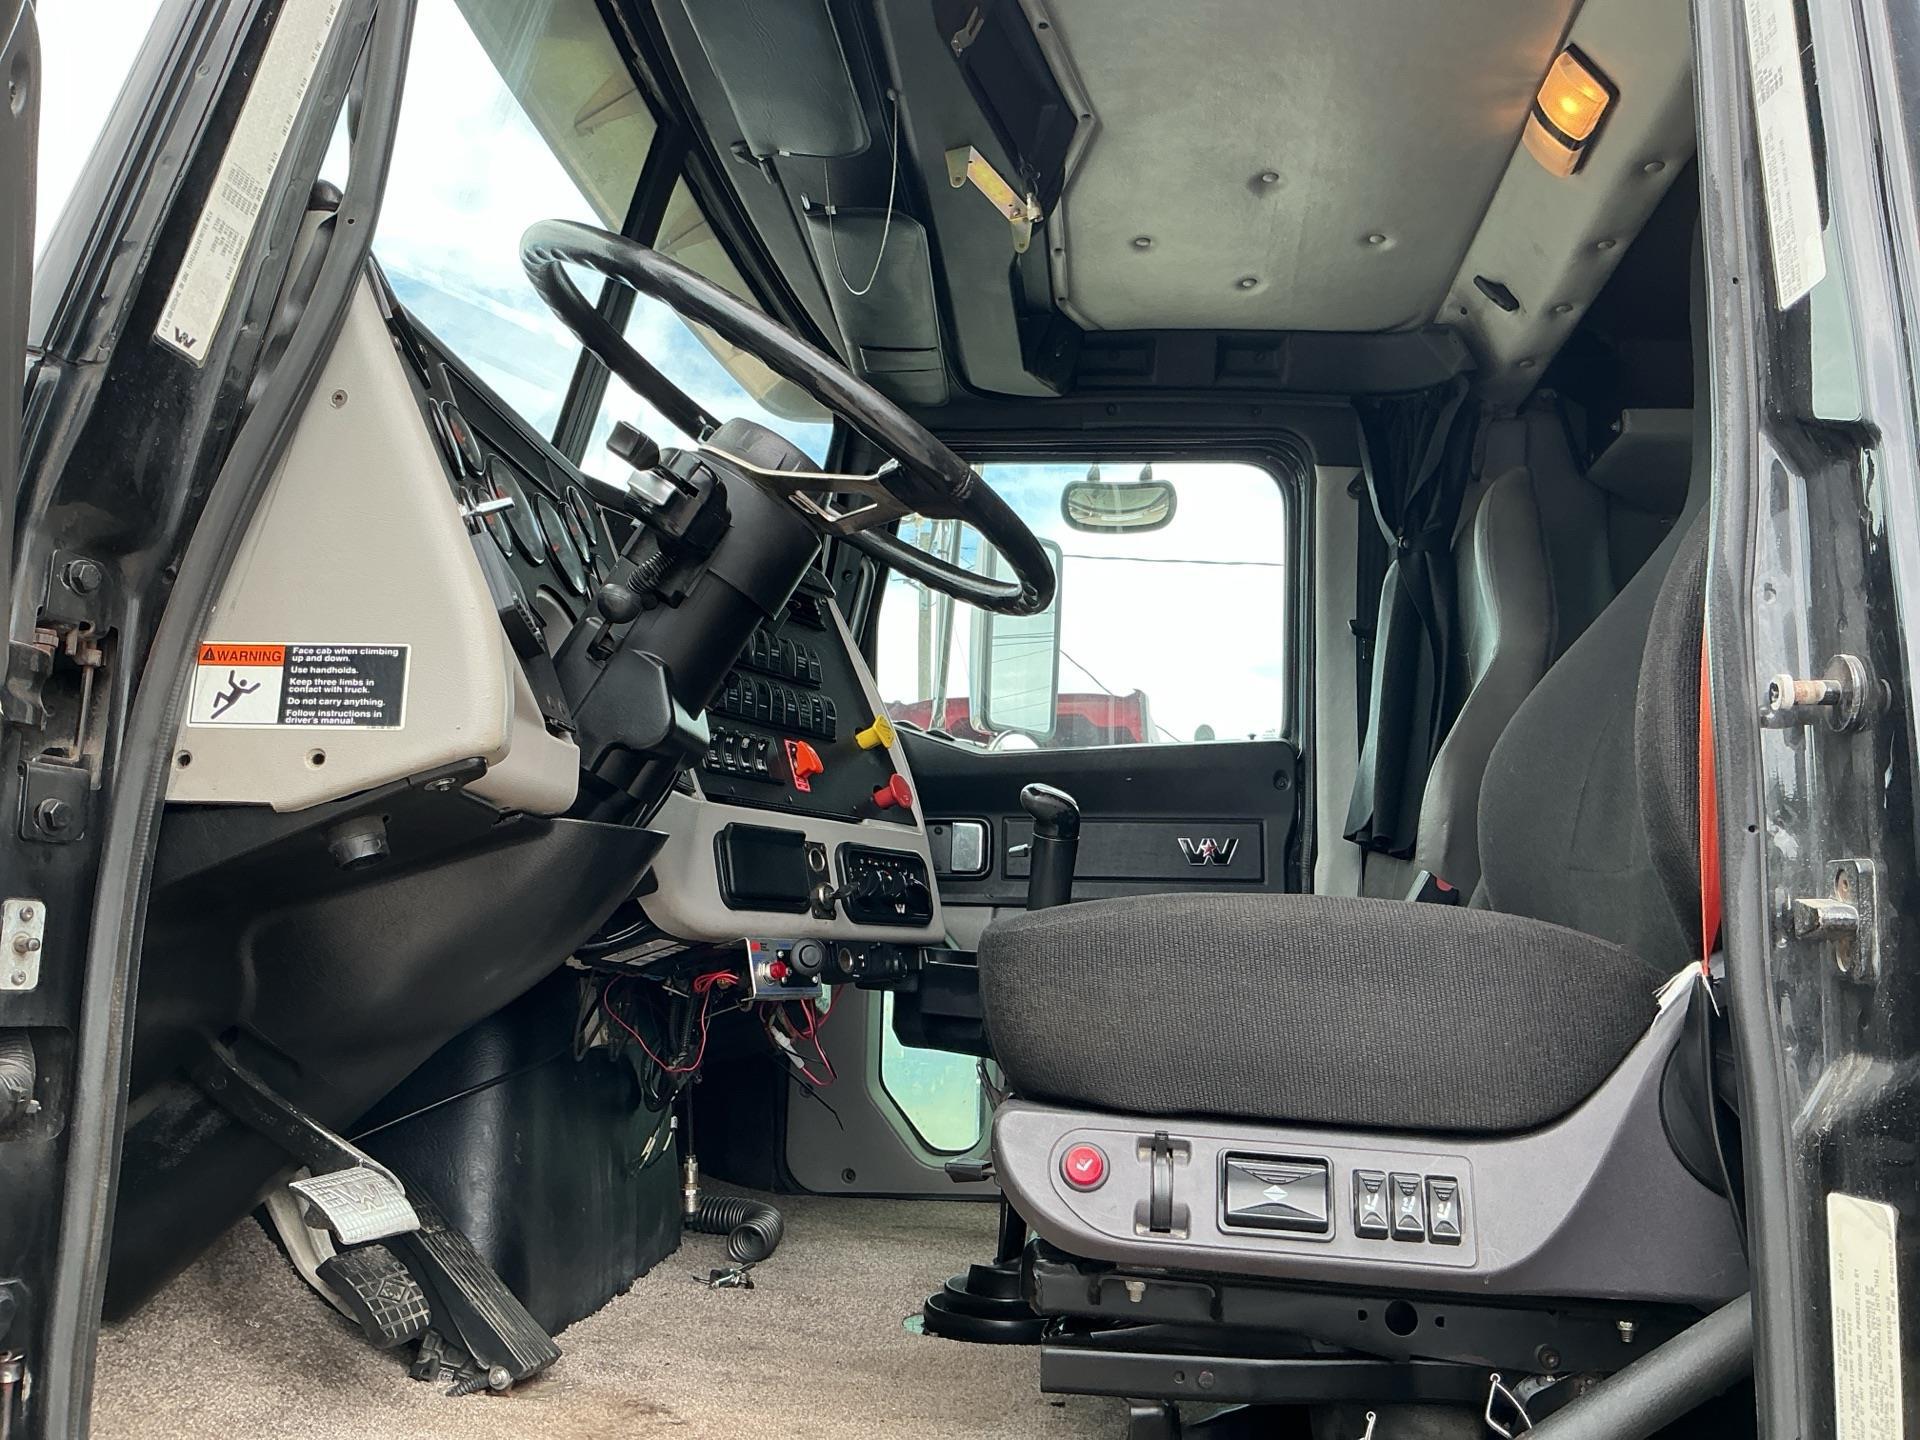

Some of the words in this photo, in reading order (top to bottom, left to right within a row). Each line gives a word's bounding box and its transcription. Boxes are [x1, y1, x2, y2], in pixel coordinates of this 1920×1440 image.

[218, 650, 282, 662] WARNING
[292, 647, 314, 655] Face
[360, 648, 399, 657] climbing
[290, 666, 308, 674] Use
[290, 678, 313, 687] Keep
[345, 686, 371, 694] truck.
[303, 697, 317, 705] not
[319, 699, 342, 707] carry
[344, 699, 386, 708] anything.
[286, 709, 316, 717] Follow
[318, 710, 371, 718] instructions
[374, 710, 382, 718] in
[286, 716, 319, 724] driver's
